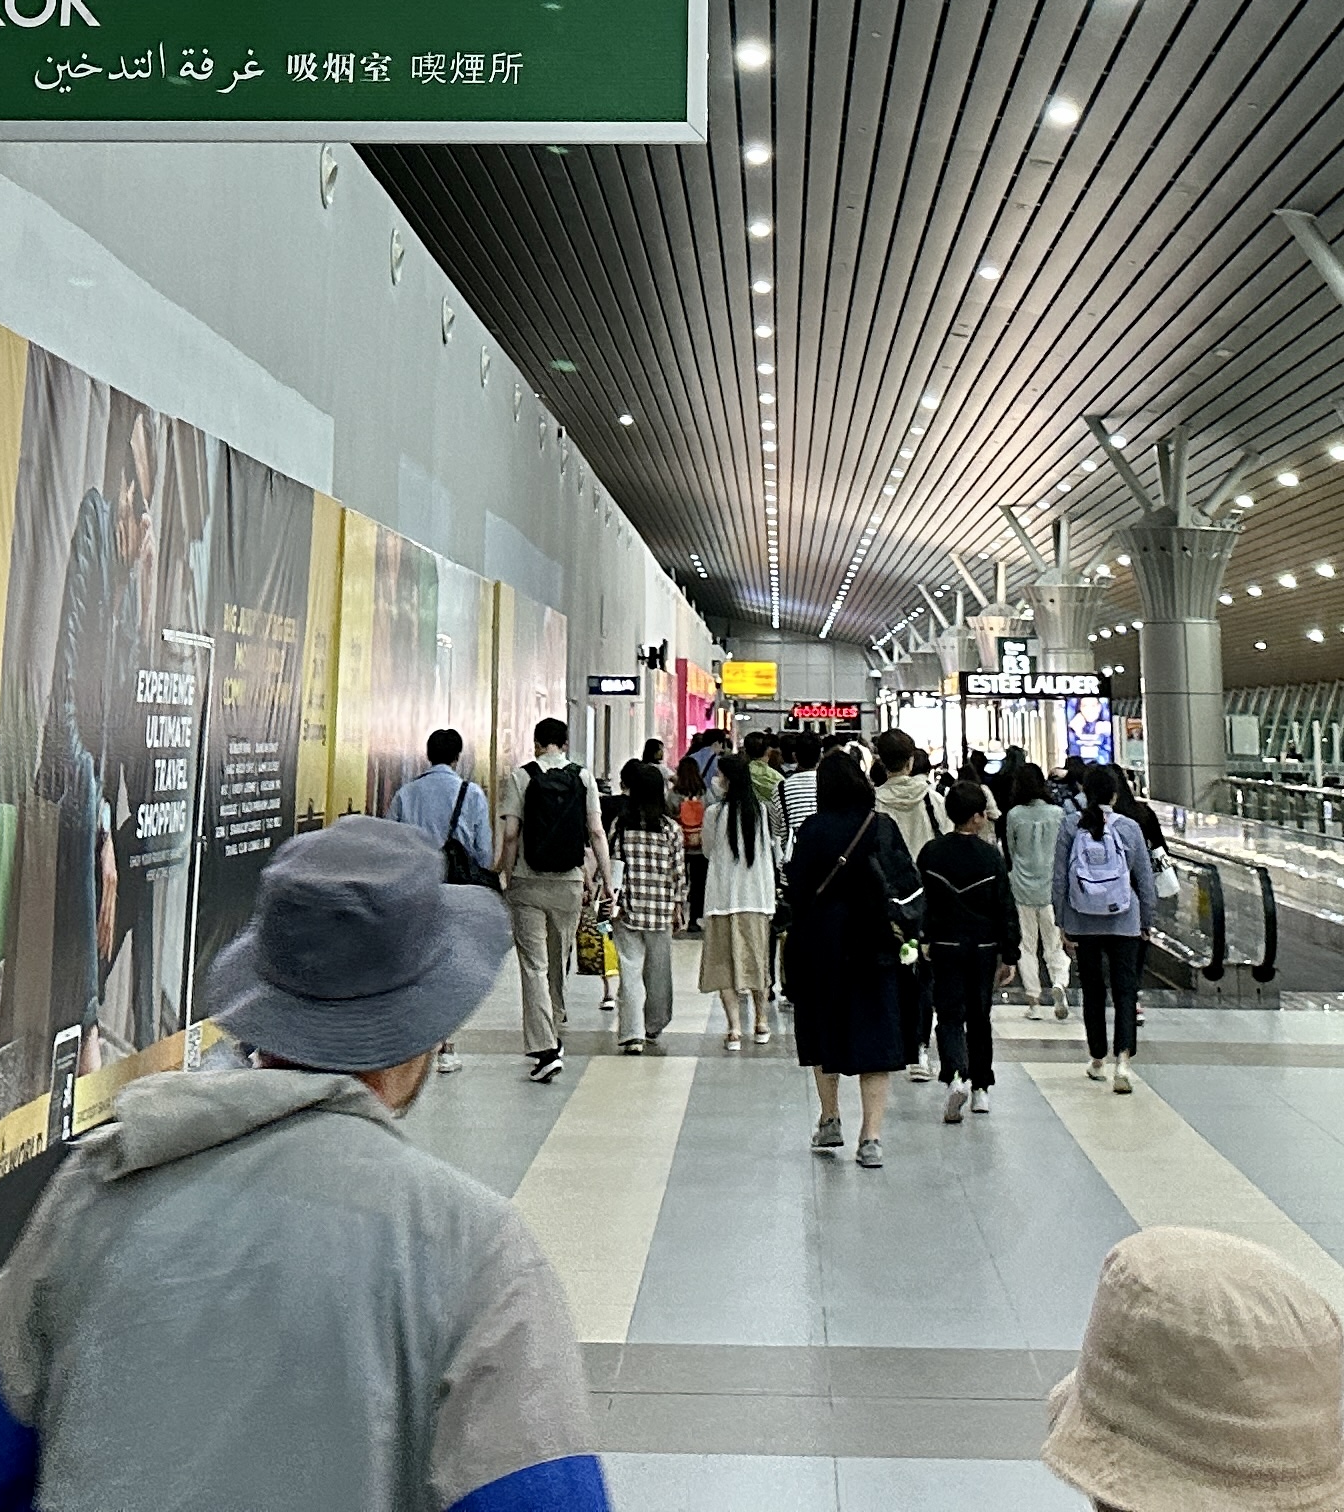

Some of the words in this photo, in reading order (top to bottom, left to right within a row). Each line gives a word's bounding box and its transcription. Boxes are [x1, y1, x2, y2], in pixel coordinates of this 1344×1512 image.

[33, 41, 168, 94] التدخين
[177, 46, 266, 94] غرفة
[286, 51, 392, 85] 吸烟室
[410, 50, 524, 86] 喫煙所
[136, 669, 196, 706] EXPERIENCE
[1024, 675, 1101, 695] LAUDER
[145, 715, 193, 749] ULTIMATE
[154, 758, 188, 792] TRAVEL
[136, 800, 187, 839] SHOPPING
